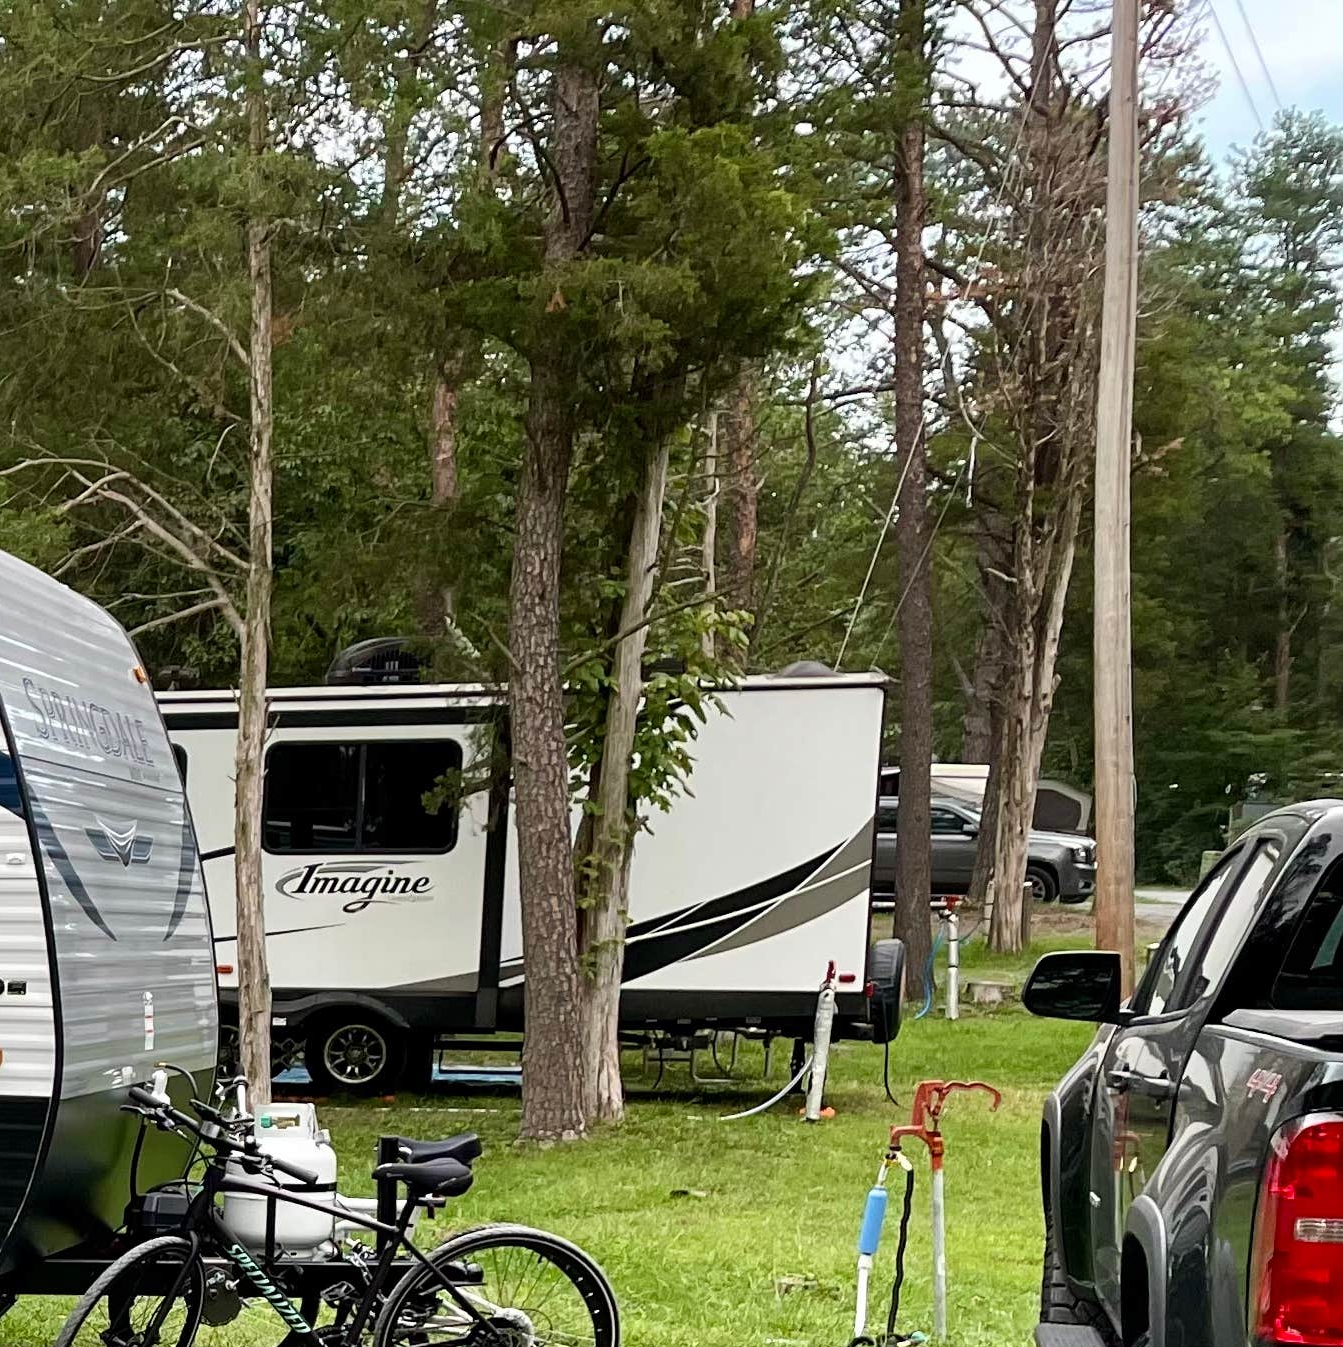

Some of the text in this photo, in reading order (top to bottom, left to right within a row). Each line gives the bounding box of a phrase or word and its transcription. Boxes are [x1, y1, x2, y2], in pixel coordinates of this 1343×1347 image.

[22, 677, 155, 768] SPRINGDALE
[290, 862, 435, 914] Imagine
[227, 1243, 313, 1334] SPECIALIZED
